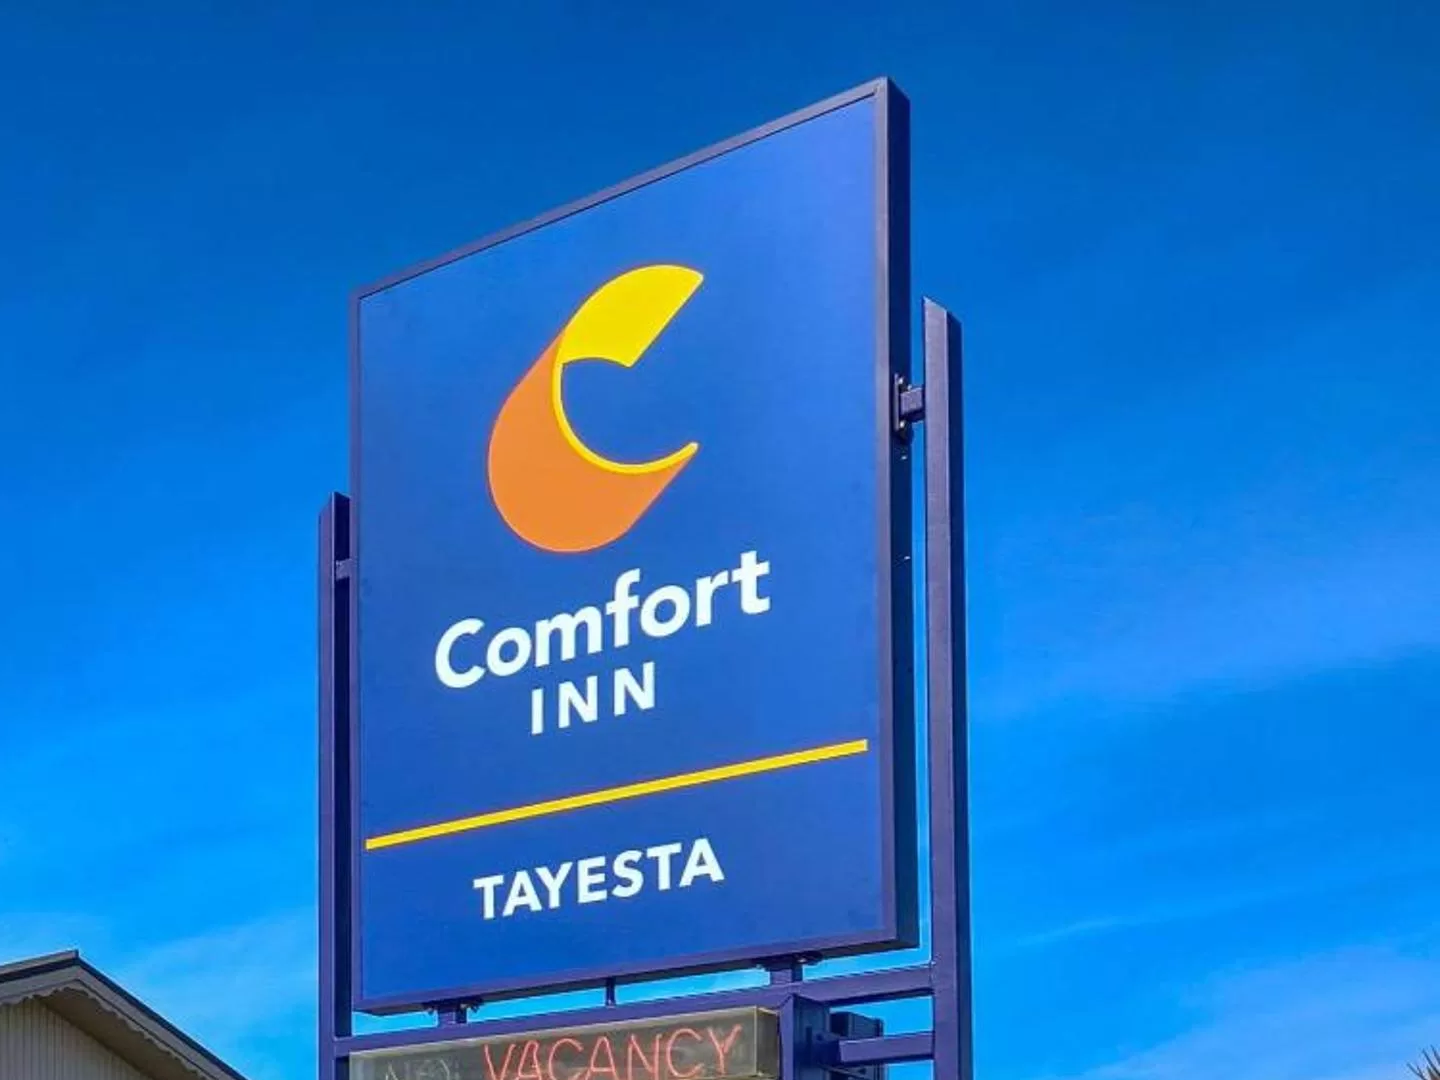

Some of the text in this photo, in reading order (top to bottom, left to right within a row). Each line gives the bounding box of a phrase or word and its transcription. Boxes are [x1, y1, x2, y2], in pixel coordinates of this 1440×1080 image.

[434, 550, 771, 689] Comfort
[529, 661, 657, 735] INN
[473, 838, 725, 920] TAYESTA
